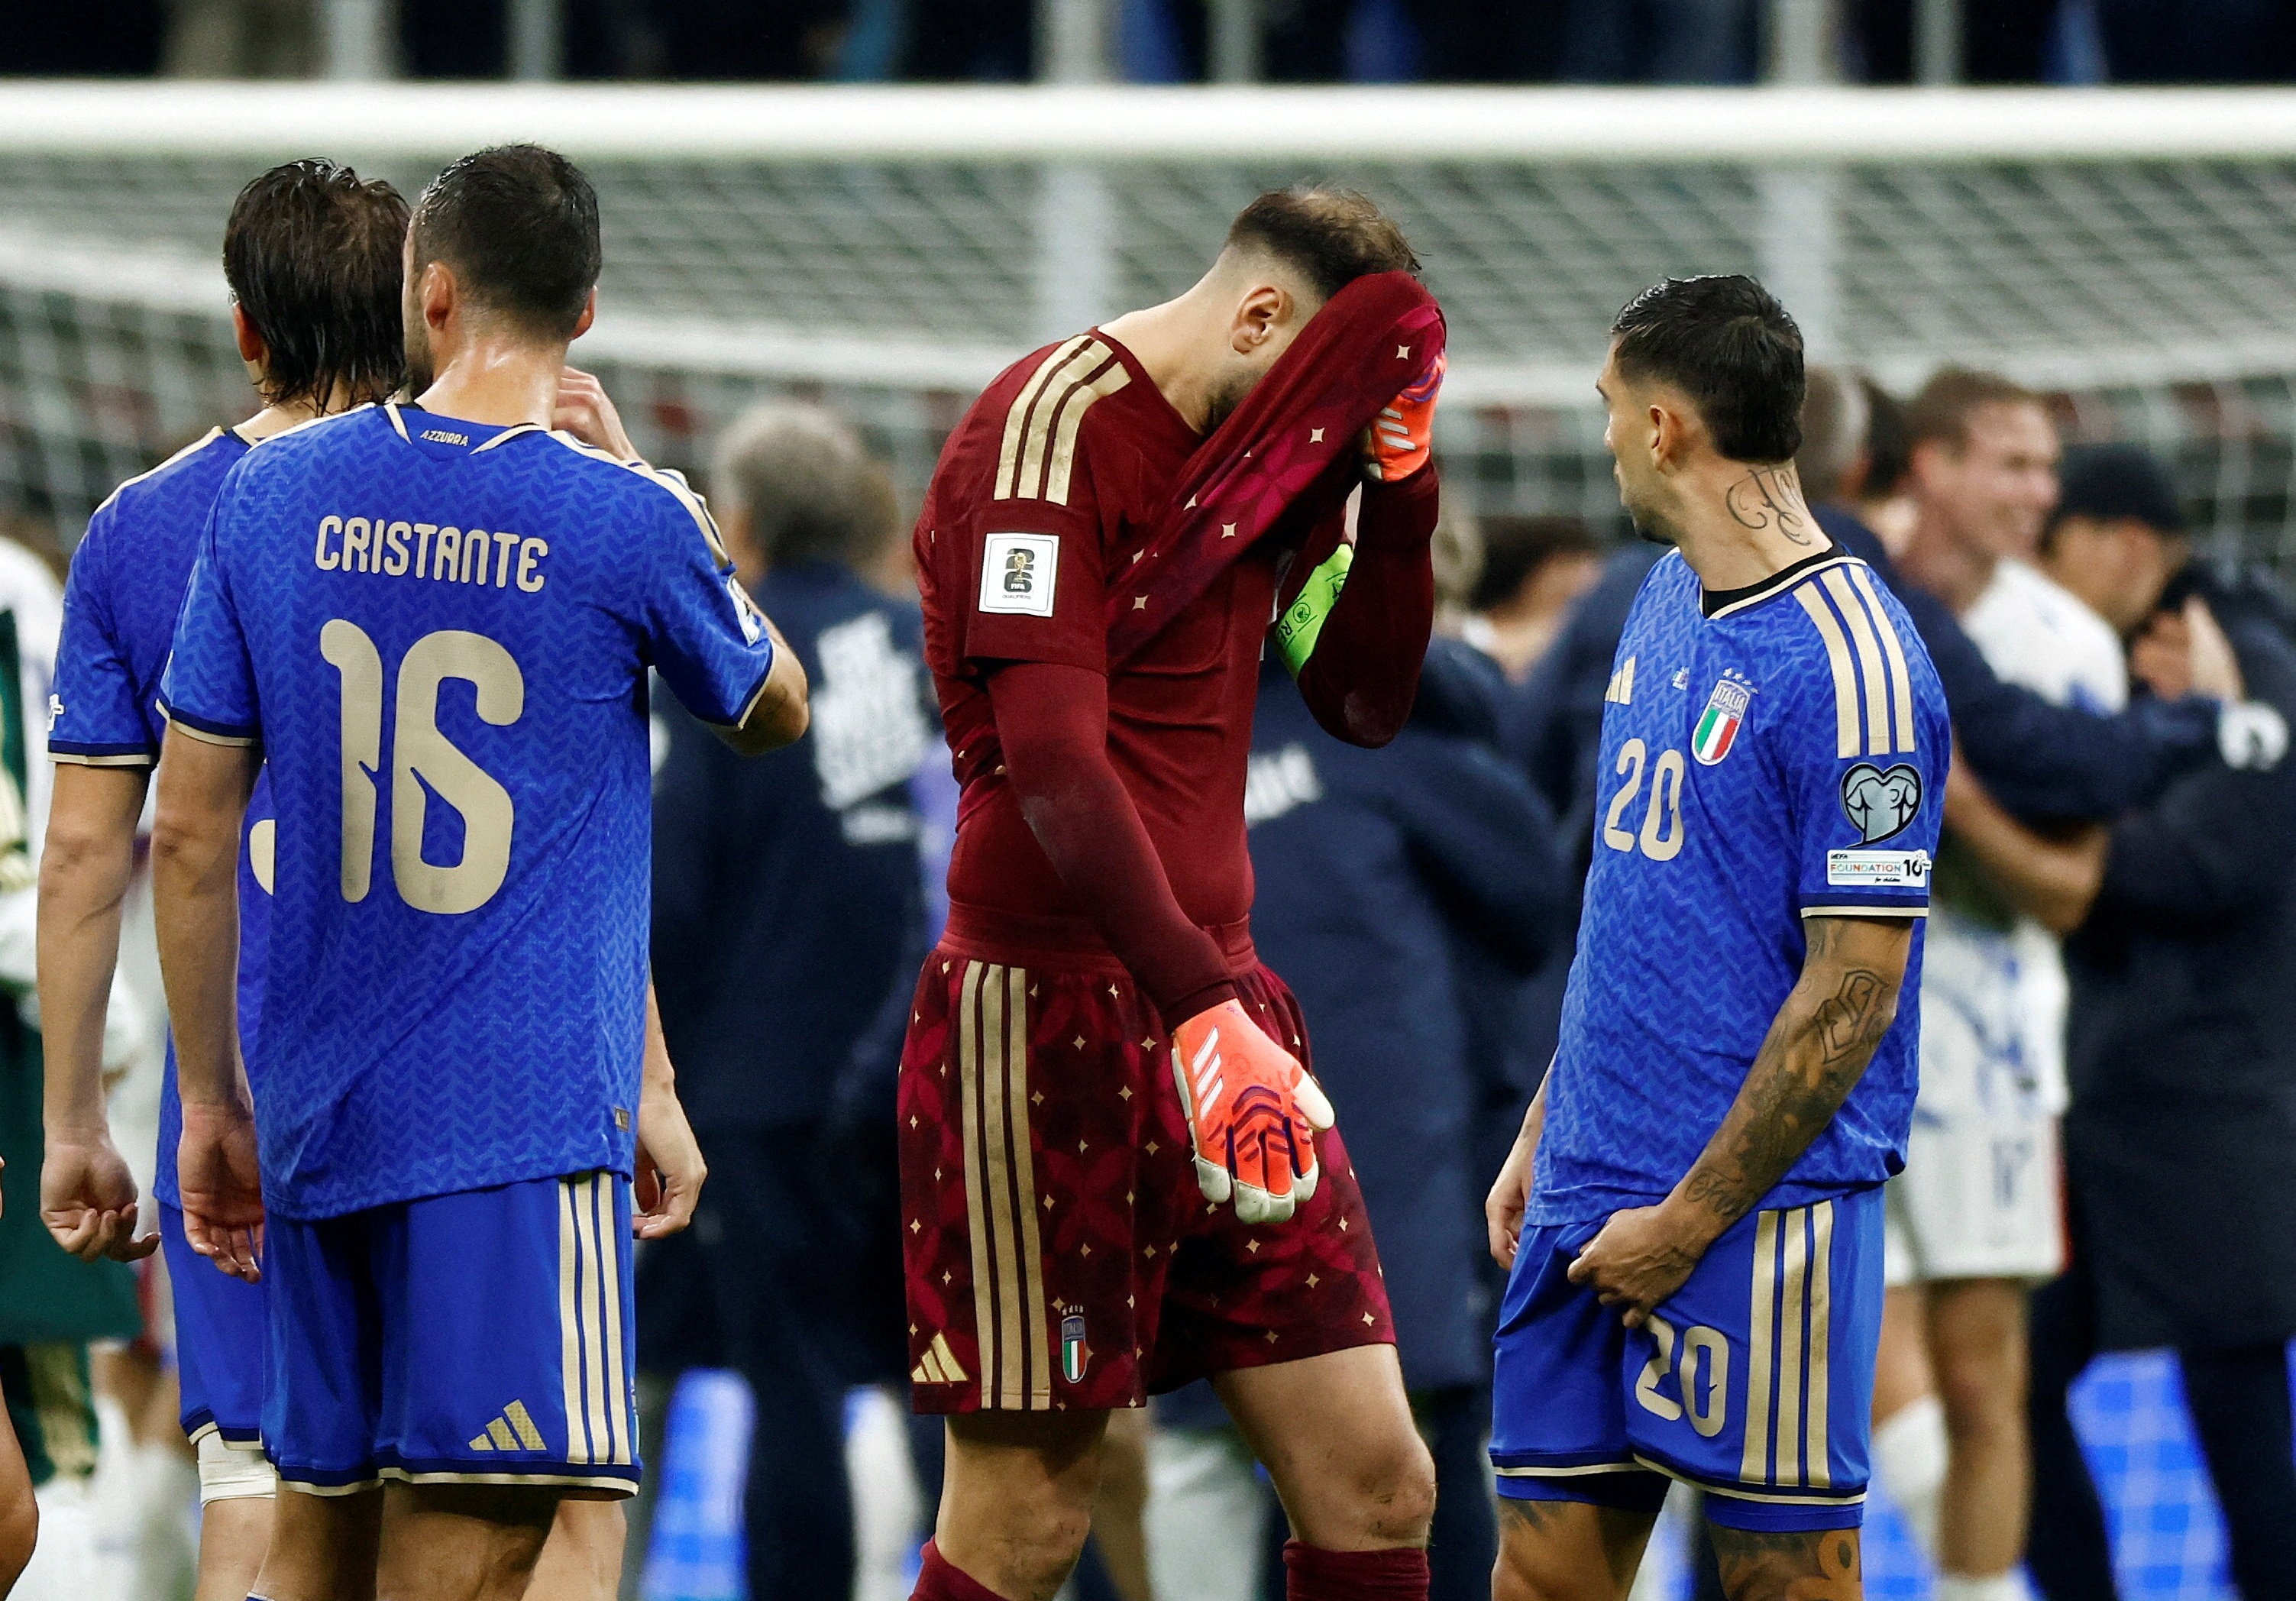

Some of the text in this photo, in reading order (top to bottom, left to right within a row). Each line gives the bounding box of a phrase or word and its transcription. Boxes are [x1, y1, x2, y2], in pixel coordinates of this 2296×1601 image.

[419, 429, 469, 447] AZZURRA
[315, 515, 548, 594] CRISTANTE
[1714, 684, 1746, 712] ITALIA
[319, 617, 525, 914] 16
[1604, 738, 1684, 862] 20
[1830, 864, 1901, 872] FOUNDATION
[1635, 1314, 1729, 1438] 20
